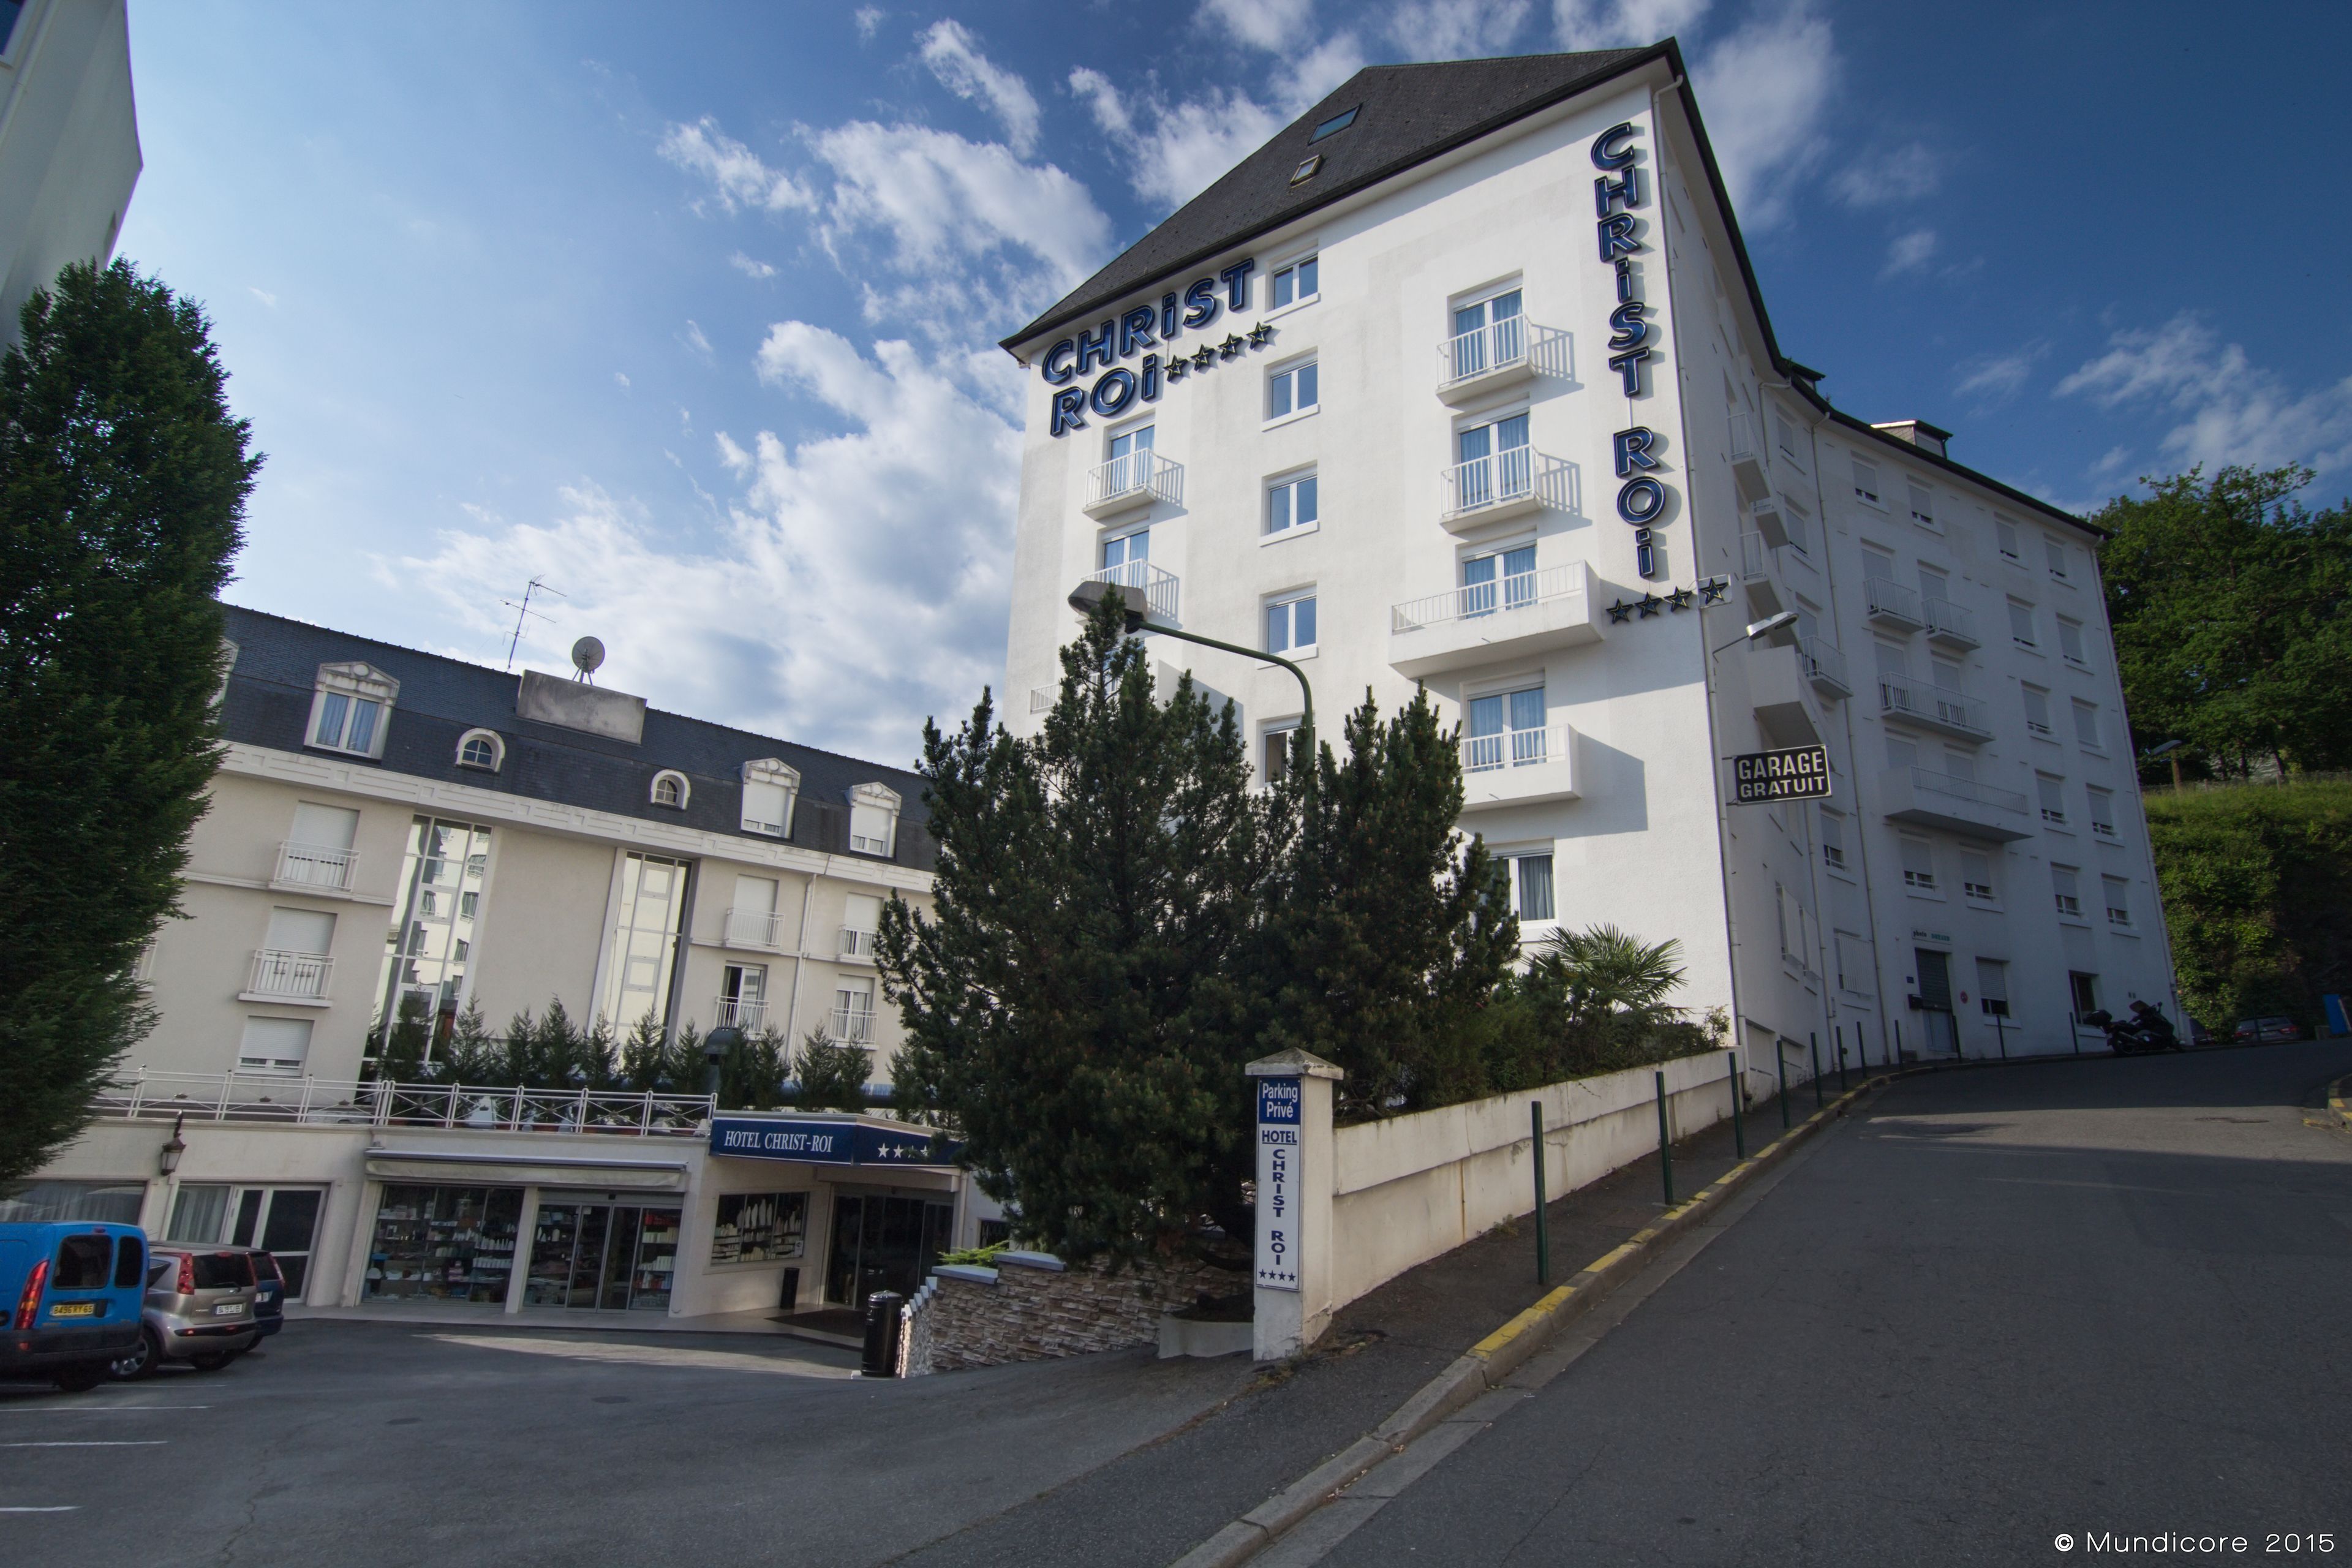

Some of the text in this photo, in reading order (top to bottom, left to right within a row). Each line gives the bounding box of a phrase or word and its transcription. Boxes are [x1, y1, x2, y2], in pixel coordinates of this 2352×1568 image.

[1738, 751, 1823, 780] GARAGE
[1740, 776, 1825, 798] GRATUIT
[1262, 1083, 1298, 1102] Parking
[1267, 1102, 1294, 1118] Privé
[724, 1131, 834, 1153] HOTEL CHRIST-ROI
[1262, 1130, 1297, 1143] HOTEL
[1271, 1149, 1286, 1265] CHRIST ROI
